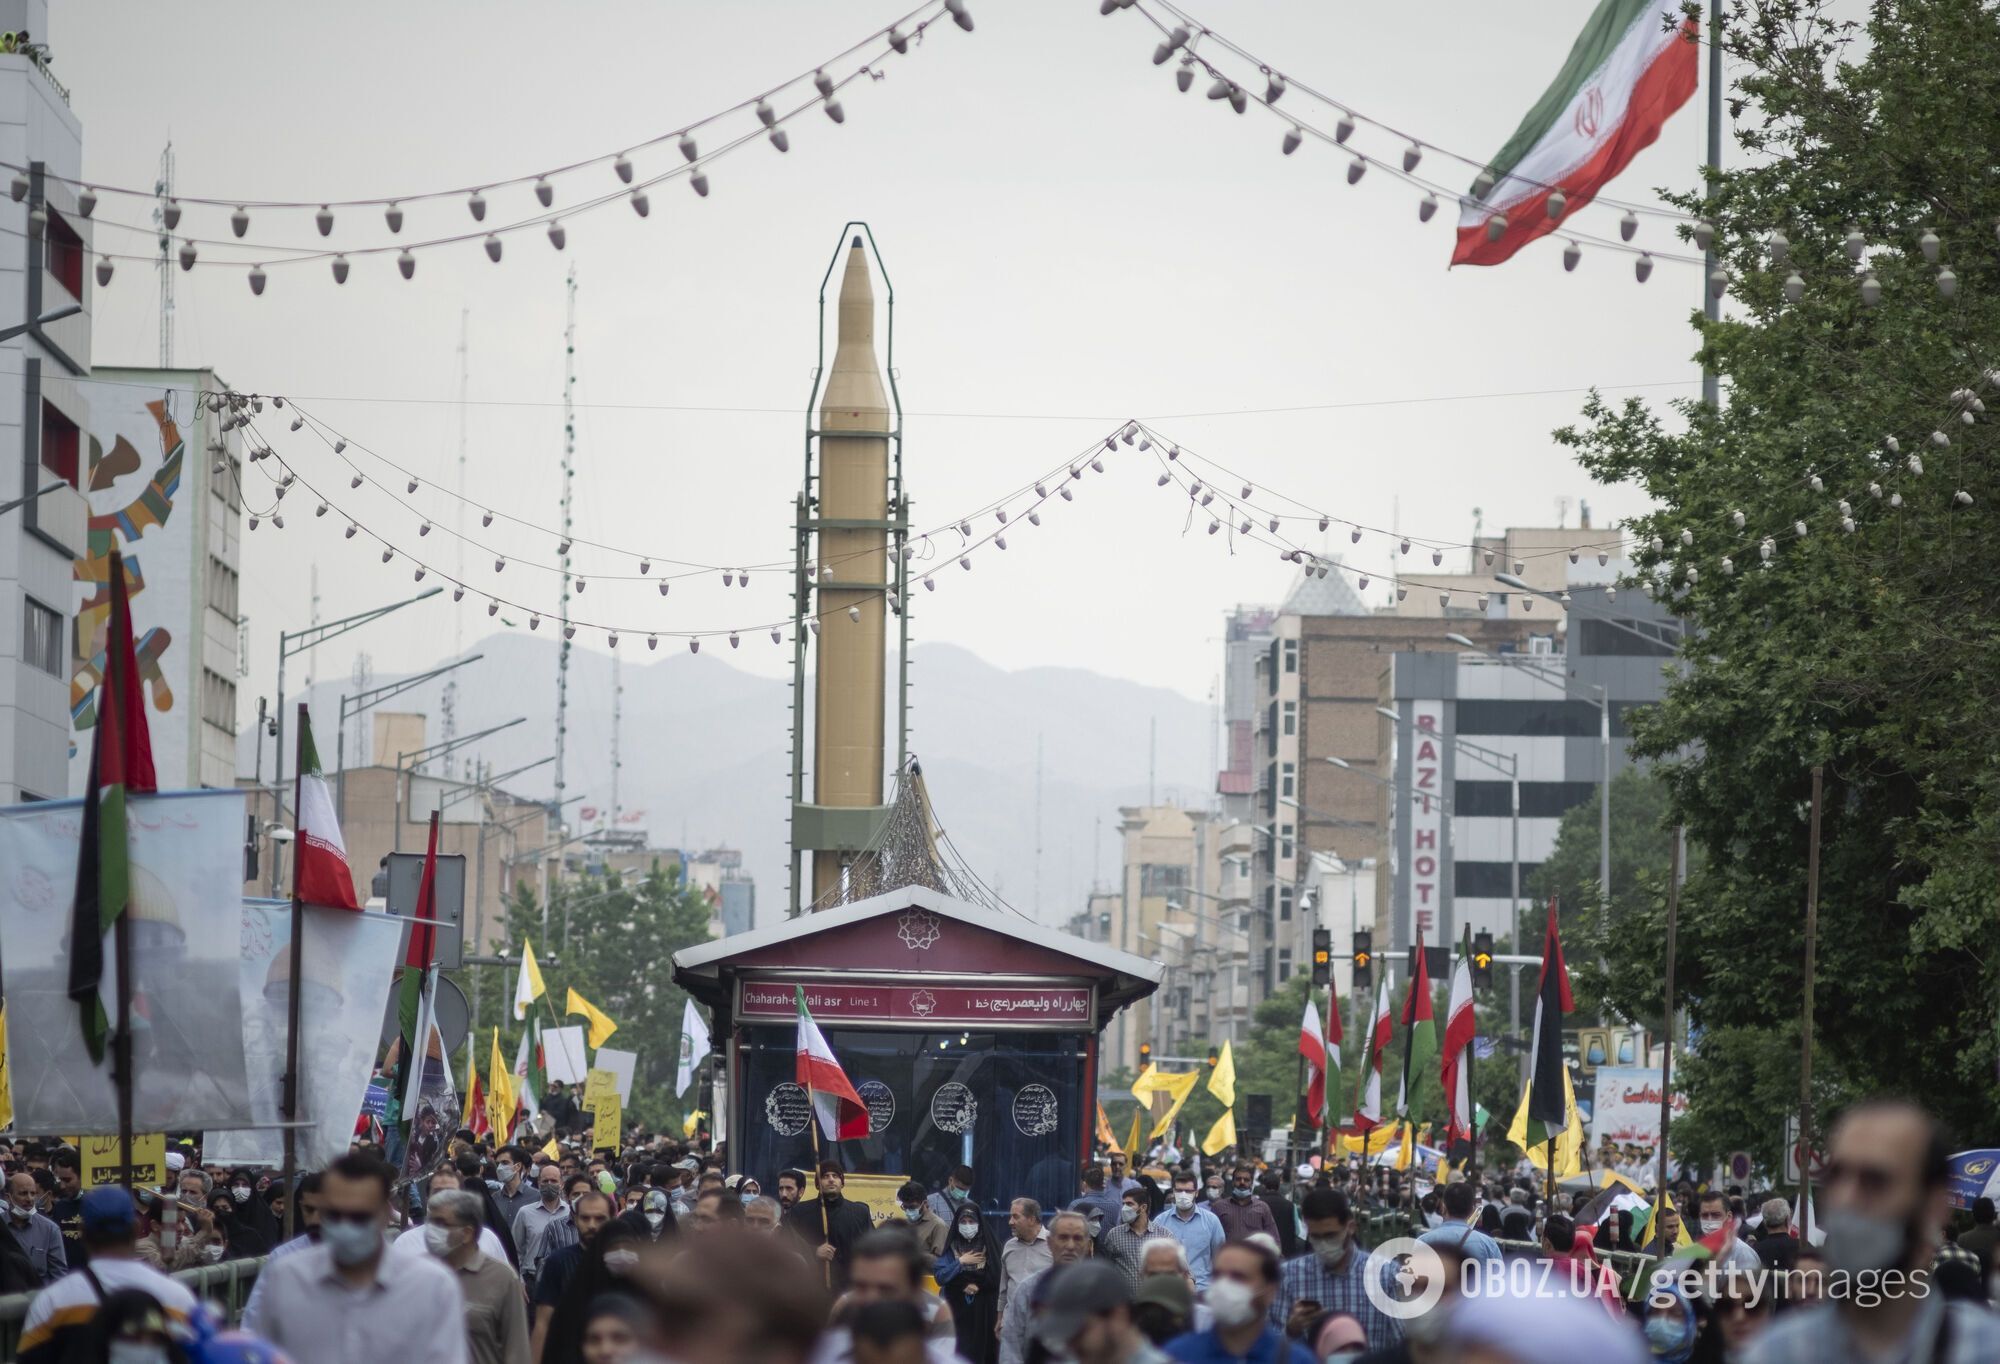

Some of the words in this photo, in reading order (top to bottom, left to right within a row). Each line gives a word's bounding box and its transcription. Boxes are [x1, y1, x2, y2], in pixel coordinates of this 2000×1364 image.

[1417, 714, 1437, 815] RAZI
[1415, 829, 1436, 931] HOTE
[824, 998, 842, 1006] asr
[850, 997, 869, 1006] Line
[872, 998, 878, 1006] 1
[975, 999, 989, 1008] خط
[92, 1168, 122, 1183] سرائیل
[137, 1166, 155, 1181] مرگ
